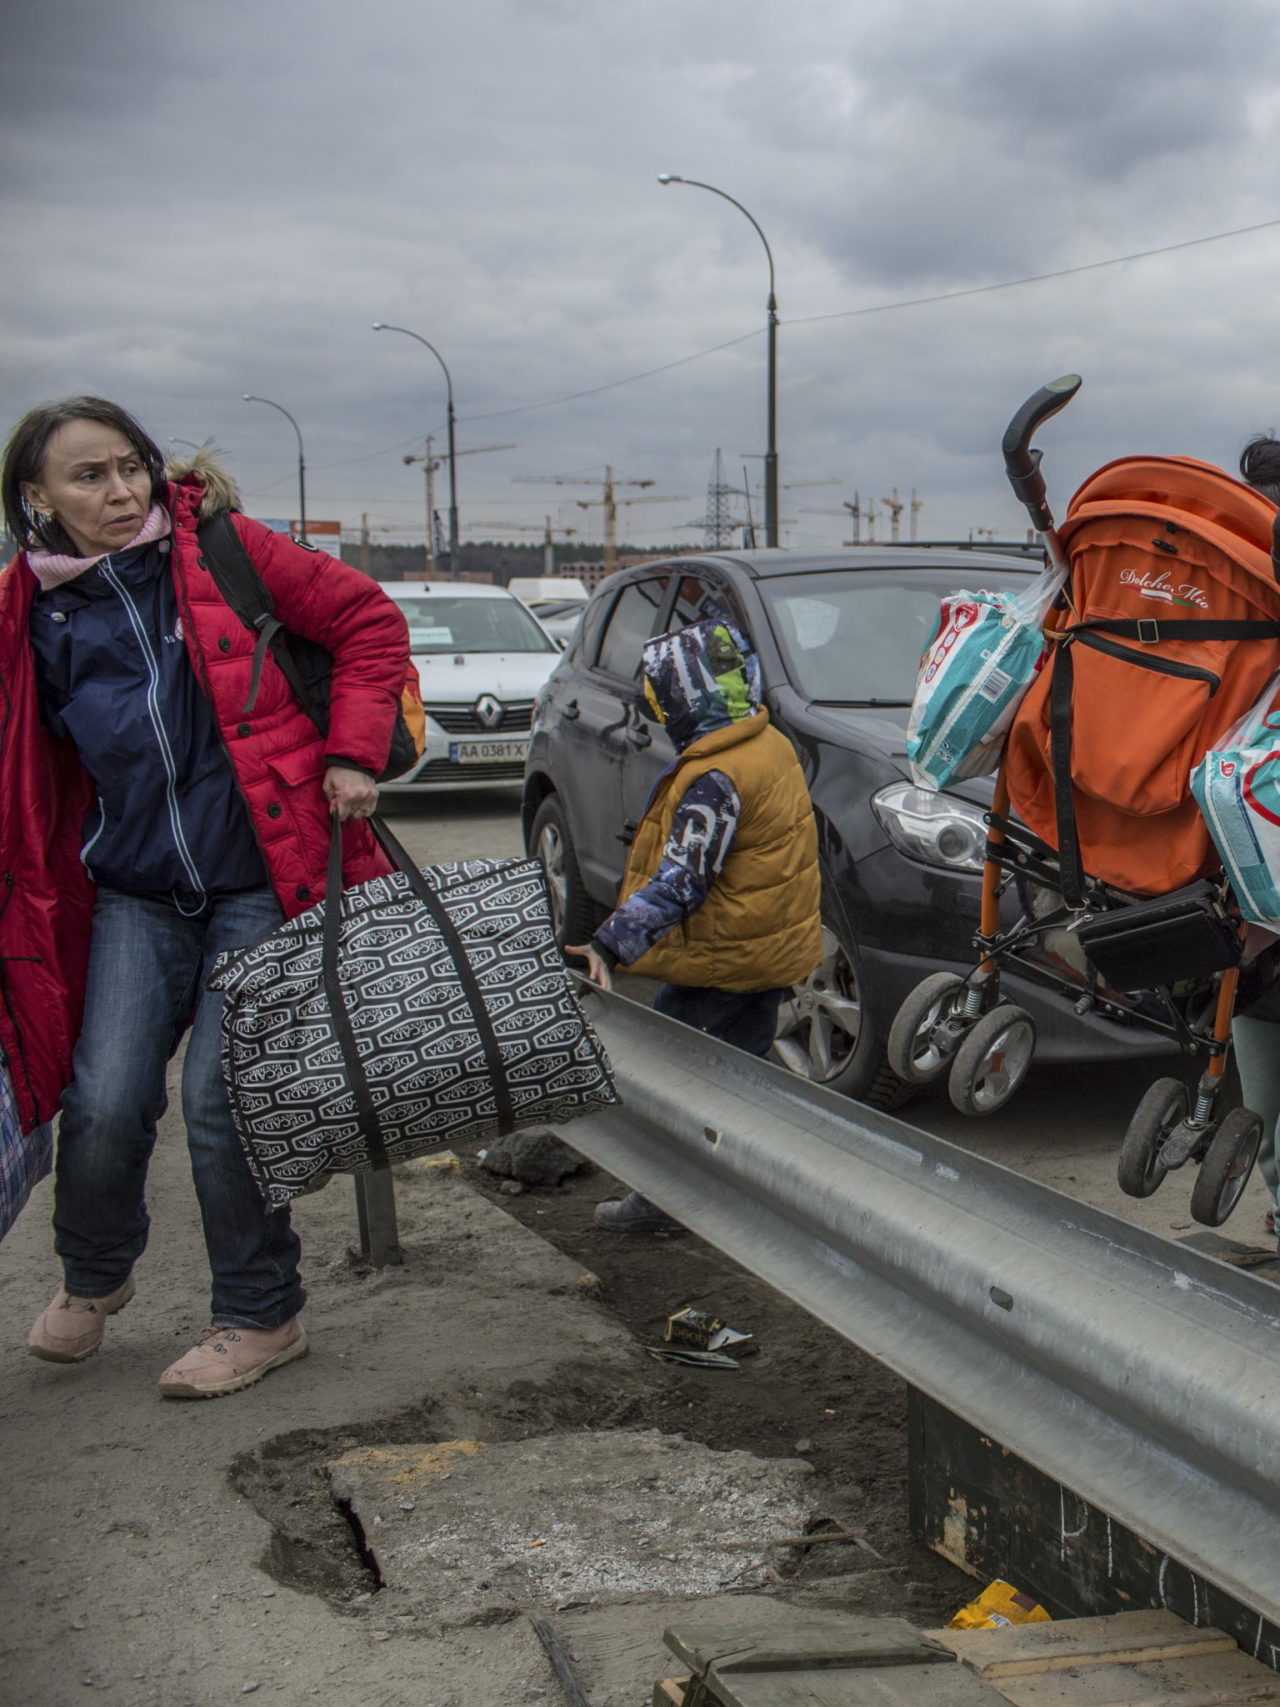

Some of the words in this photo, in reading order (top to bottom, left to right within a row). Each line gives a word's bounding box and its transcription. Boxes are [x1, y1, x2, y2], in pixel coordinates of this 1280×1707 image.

[460, 745, 479, 758] AA
[481, 744, 511, 757] 0381
[351, 1008, 394, 1028] DÉCAD
[365, 1056, 411, 1077] DÉCAD
